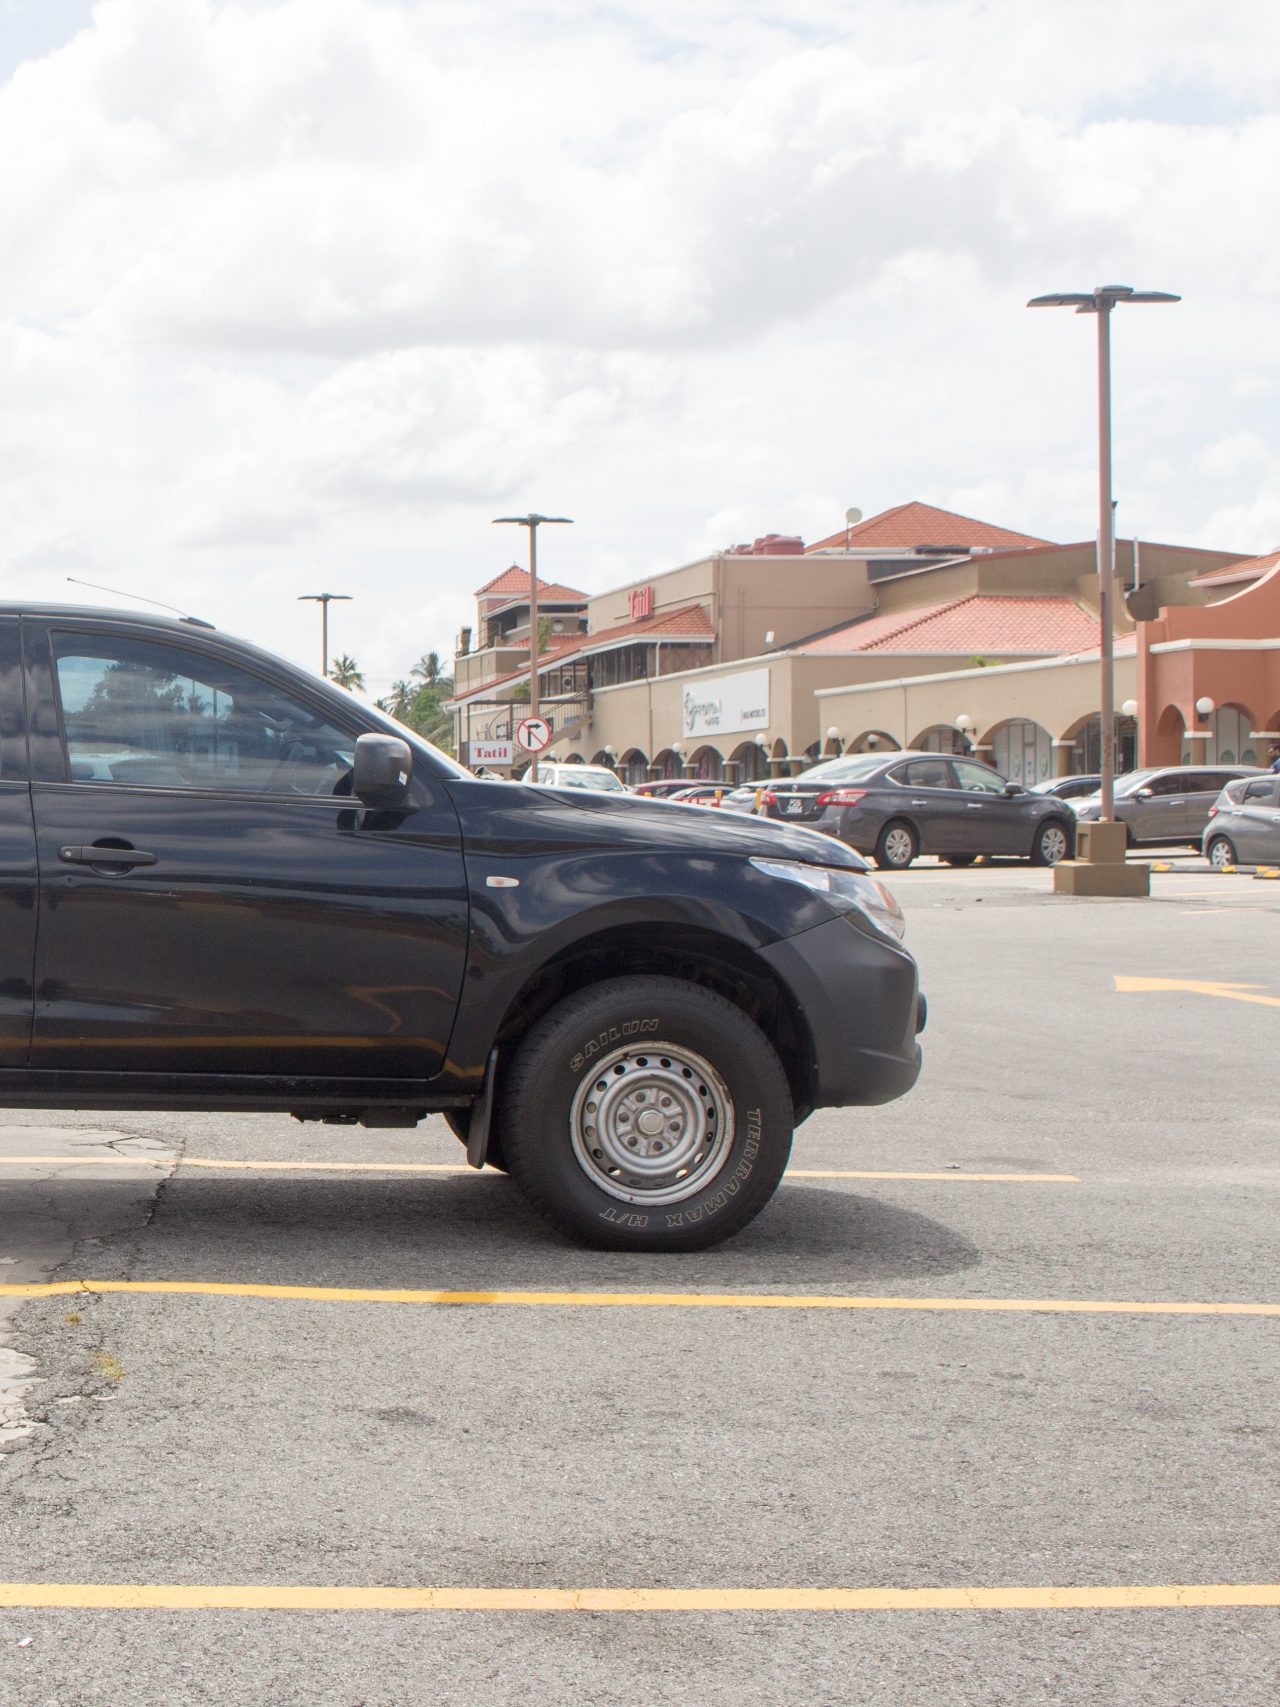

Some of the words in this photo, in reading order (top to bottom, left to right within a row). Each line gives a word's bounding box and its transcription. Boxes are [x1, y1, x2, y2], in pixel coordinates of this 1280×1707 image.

[628, 586, 652, 621] Tatil
[475, 747, 507, 758] Tatil
[569, 1018, 659, 1072] SAILUN
[666, 1107, 762, 1227] TERRAMAX
[598, 1206, 648, 1227] H/T
